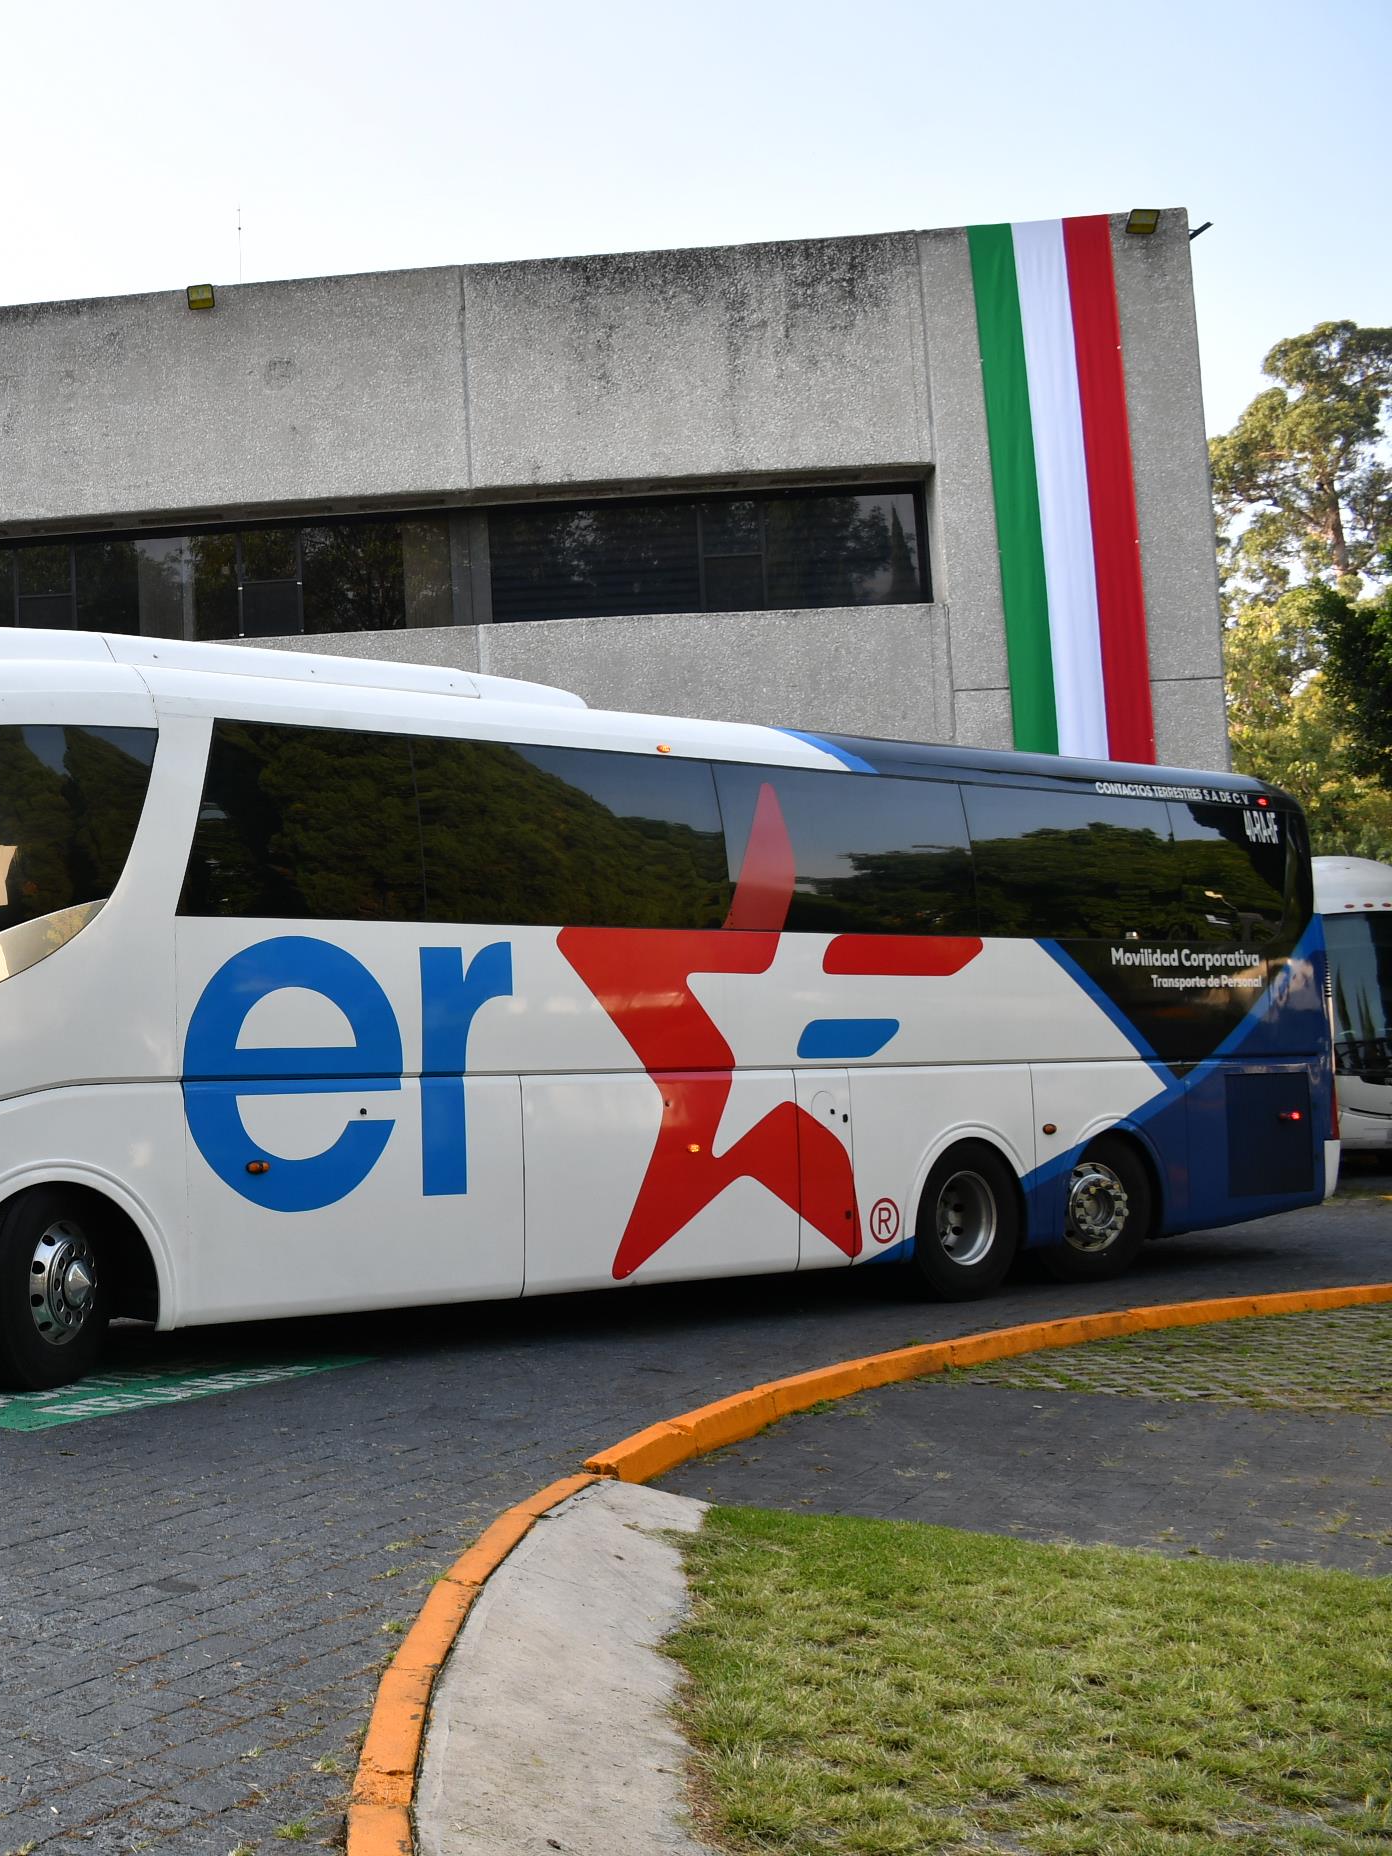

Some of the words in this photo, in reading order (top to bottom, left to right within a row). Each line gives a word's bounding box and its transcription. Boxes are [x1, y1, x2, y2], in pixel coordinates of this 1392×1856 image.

[1095, 781, 1152, 797] CONTACTOS
[1152, 785, 1202, 801] TERRESTRES
[1220, 791, 1232, 804] DE
[1111, 947, 1179, 966] Movilidad
[1181, 949, 1259, 970] Corporativa
[1151, 974, 1206, 991] Transporte
[1207, 975, 1220, 987] de
[1221, 975, 1262, 988] Personal
[183, 935, 512, 1213] er
